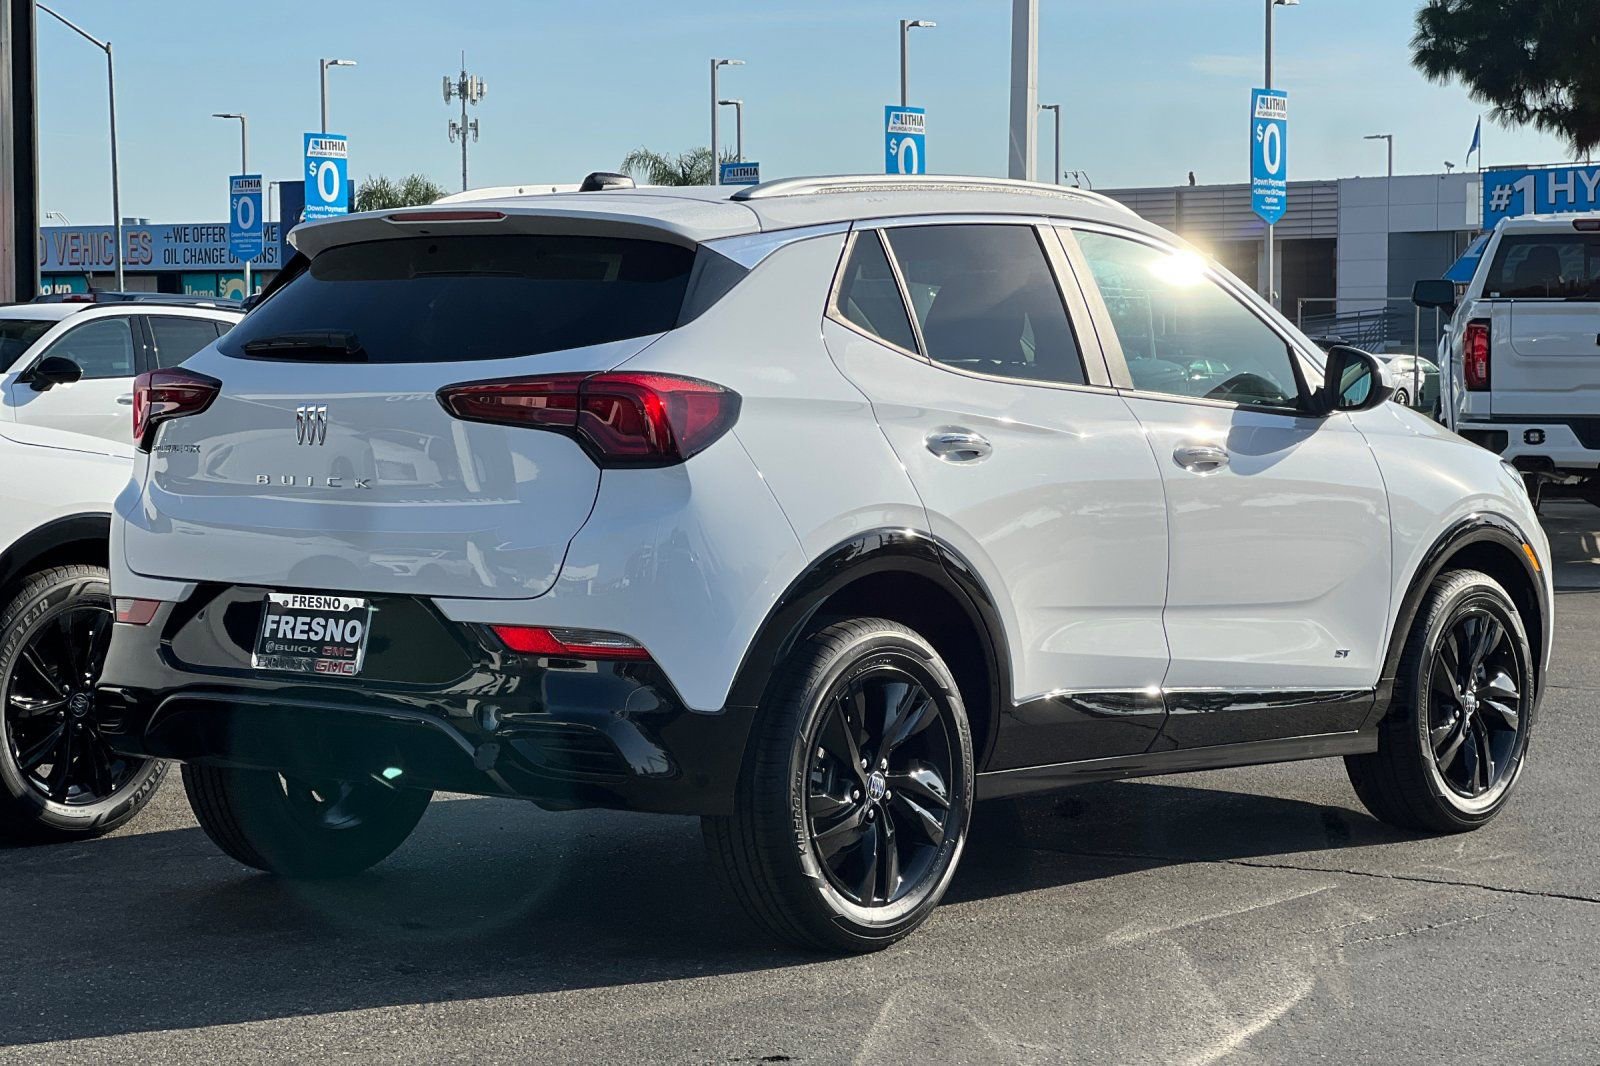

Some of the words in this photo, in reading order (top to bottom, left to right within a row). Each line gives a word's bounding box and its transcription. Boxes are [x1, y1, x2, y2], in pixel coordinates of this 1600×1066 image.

[1265, 97, 1286, 111] LITHIA
[900, 113, 924, 127] LITHIA
[320, 140, 346, 152] LITHIA
[1256, 123, 1281, 174] $0
[890, 138, 918, 174] $0
[732, 167, 758, 177] LITHIA
[240, 179, 261, 188] LITHIA
[309, 161, 340, 203] $0
[1254, 177, 1269, 186] Down
[1489, 174, 1535, 215] #1
[1547, 169, 1600, 204] HY
[232, 197, 255, 230] $0
[307, 204, 324, 212] Down
[164, 226, 190, 243] +WE
[192, 226, 226, 243] OFFER
[54, 231, 153, 266] VEHICES
[164, 248, 181, 265] OIL
[183, 247, 226, 265] CHANGE
[256, 474, 372, 489] BUICK
[291, 595, 341, 610] FRESNO
[263, 614, 362, 644] FRESNO
[274, 643, 318, 654] BUICK
[321, 645, 354, 657] GMC
[1334, 649, 1351, 659] ST
[314, 660, 355, 674] GMC
